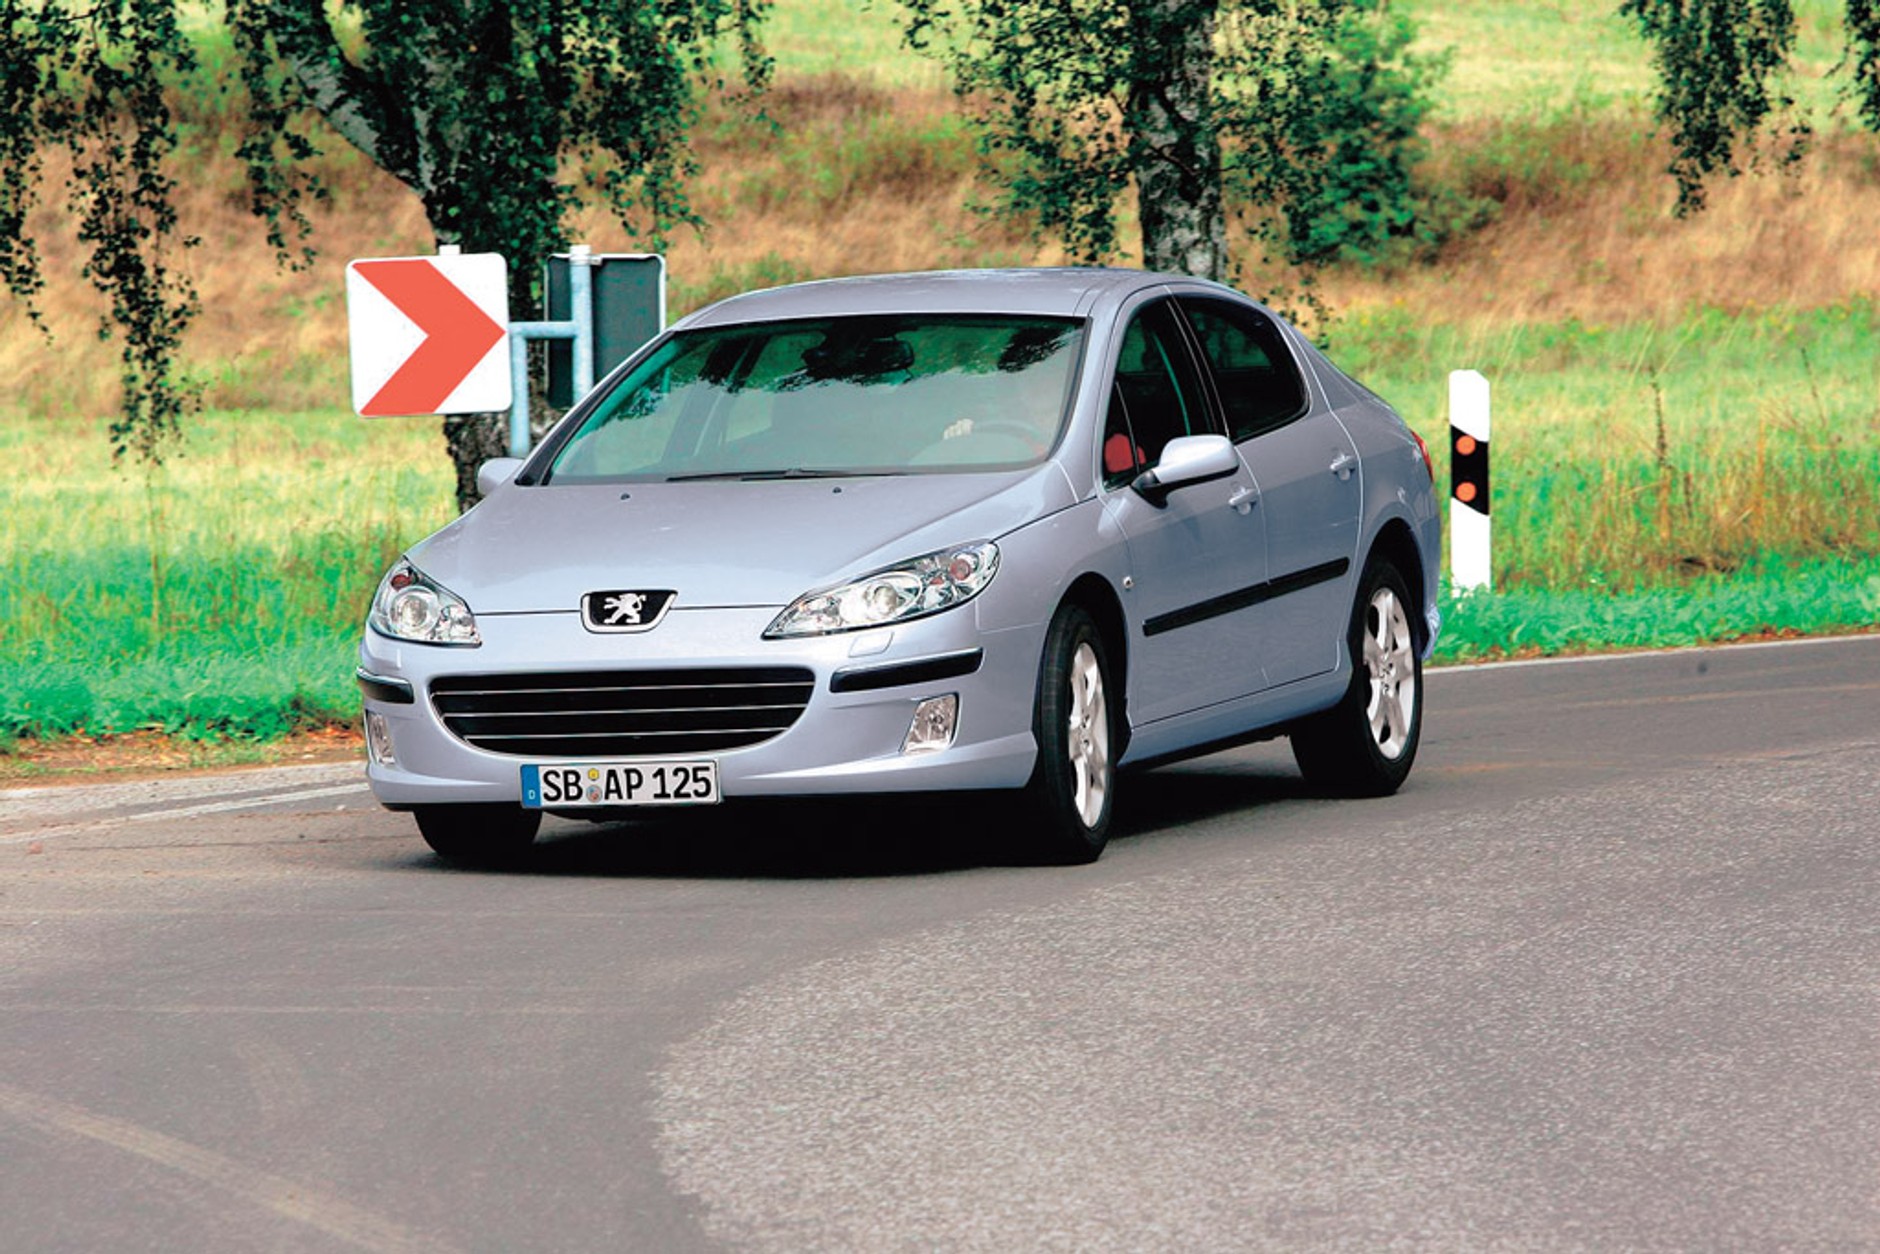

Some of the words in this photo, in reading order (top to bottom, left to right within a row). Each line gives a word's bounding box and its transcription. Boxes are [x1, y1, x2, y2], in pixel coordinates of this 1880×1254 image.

[543, 770, 582, 801] SB
[604, 768, 643, 800] AP
[652, 766, 711, 799] 125
